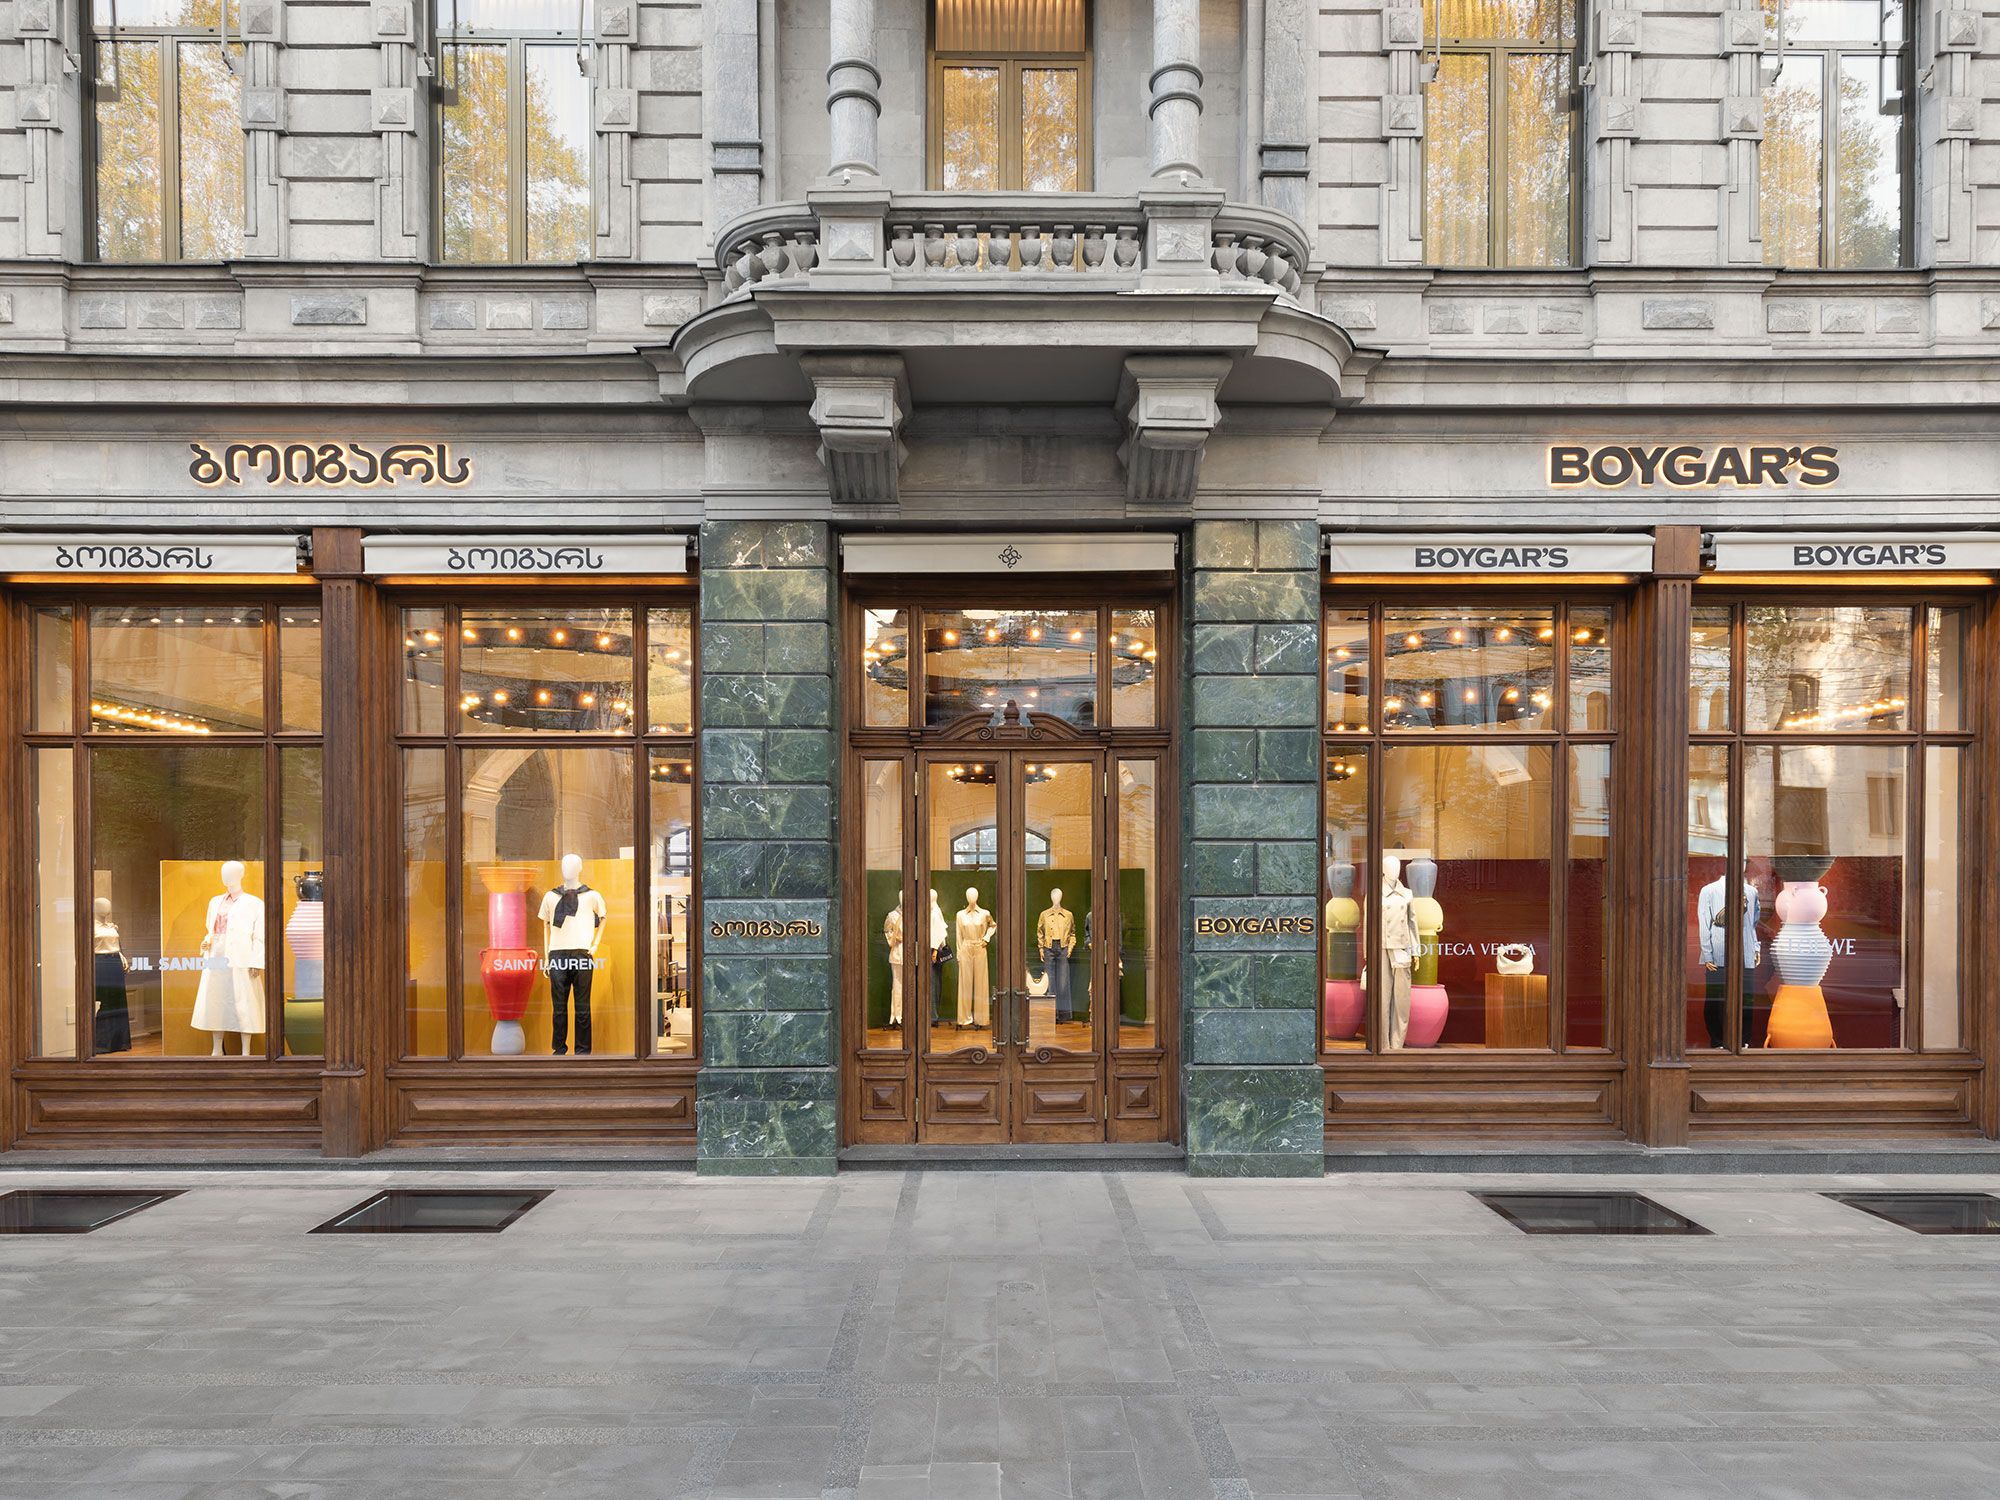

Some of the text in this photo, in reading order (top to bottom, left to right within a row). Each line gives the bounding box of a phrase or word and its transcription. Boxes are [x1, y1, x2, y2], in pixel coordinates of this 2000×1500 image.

[189, 443, 471, 484] ბოიგარს
[1550, 446, 1840, 485] BOYGAR'S
[55, 546, 213, 569] ბოიგარს
[447, 547, 603, 570] ბოიგარს
[1415, 547, 1569, 569] BOYGAR'S
[1793, 544, 1947, 566] BOYGAR'S
[710, 919, 821, 937] ბოიგარს
[1196, 917, 1315, 934] BOYGAR'S
[129, 957, 153, 971] JIL
[493, 958, 607, 971] SAINT LAURENT
